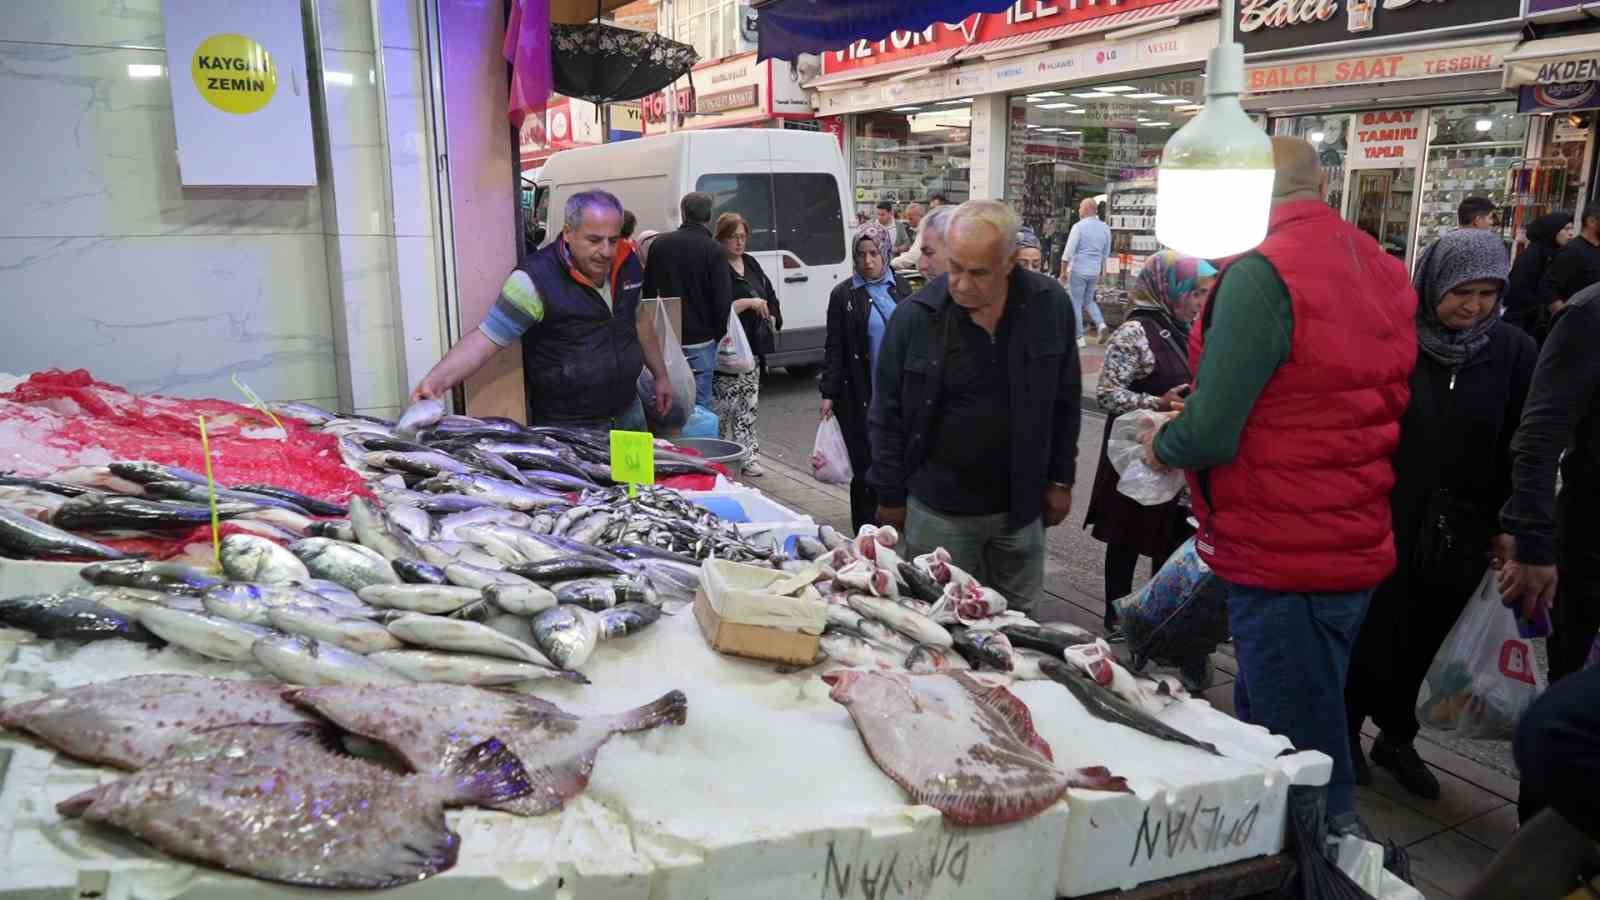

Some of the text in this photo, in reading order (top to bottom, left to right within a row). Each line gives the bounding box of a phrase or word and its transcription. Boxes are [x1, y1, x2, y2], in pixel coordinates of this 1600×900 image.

[1106, 51, 1117, 61] LG
[198, 55, 268, 73] KAYG
[1250, 65, 1317, 90] BALCI
[1335, 56, 1403, 81] SAAT
[207, 77, 264, 92] ZEMİN
[1362, 111, 1414, 125] SAAT
